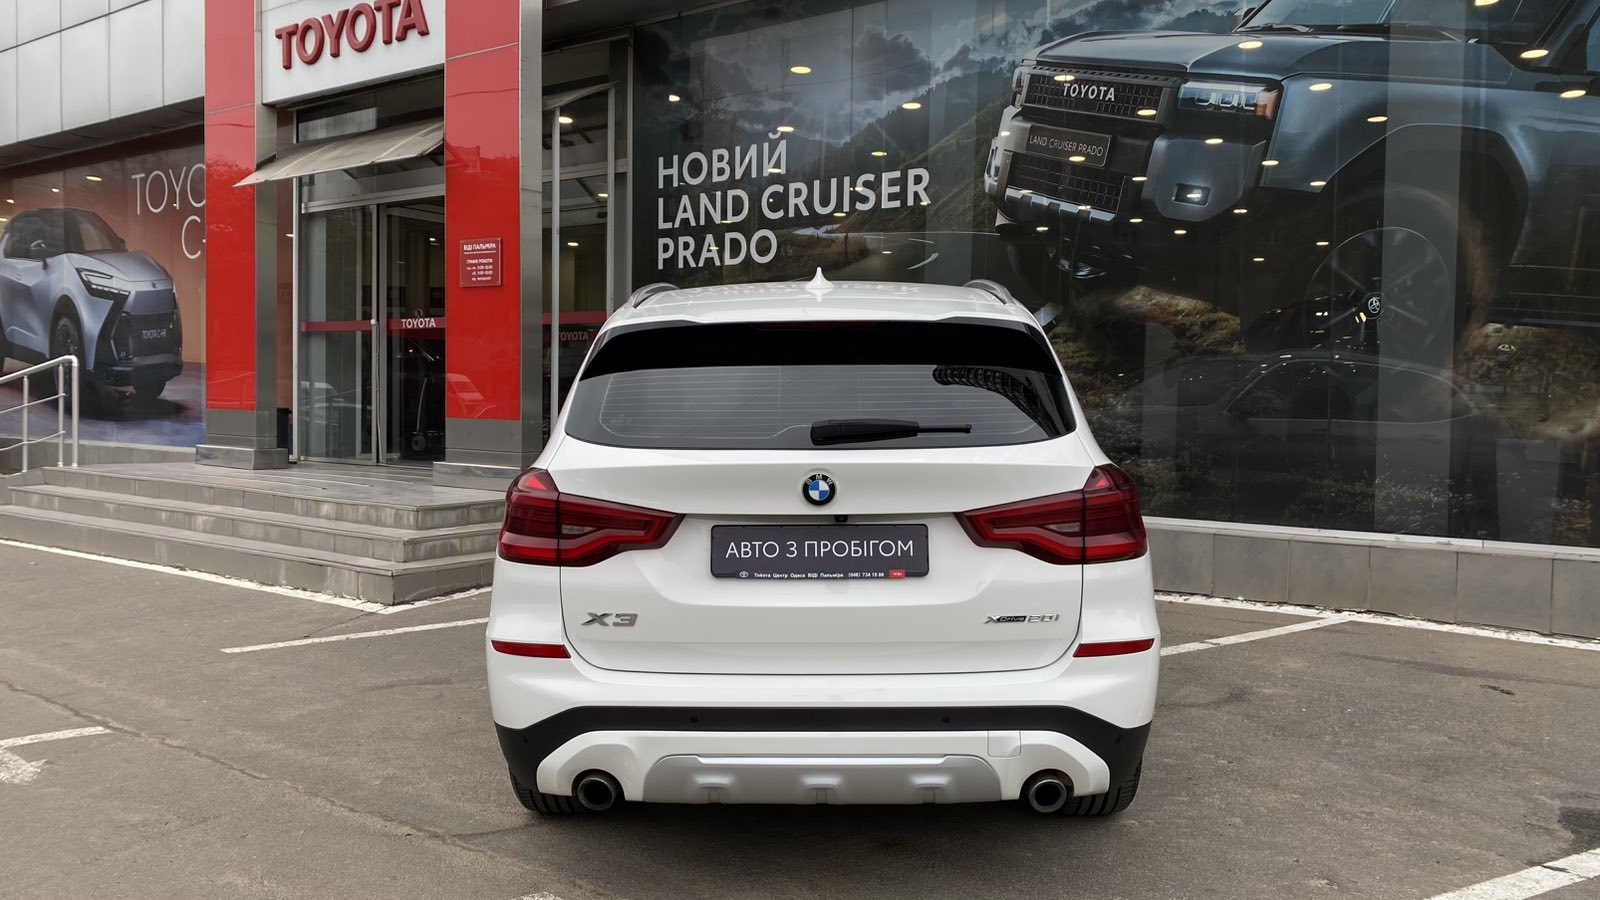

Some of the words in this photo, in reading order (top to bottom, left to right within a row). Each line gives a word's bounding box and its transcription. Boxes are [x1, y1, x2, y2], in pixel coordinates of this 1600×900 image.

[275, 0, 430, 70] TOYOTA
[1063, 82, 1115, 101] TOYOTA
[1029, 134, 1048, 147] LAND
[1048, 138, 1077, 152] CRUISER
[1077, 143, 1104, 157] PRADO
[658, 131, 787, 189] НОВИЙ
[658, 188, 749, 230] LAND
[760, 167, 931, 220] CRUISER
[658, 228, 778, 270] PRADO
[401, 317, 436, 329] TOYOTA
[560, 331, 589, 341] OYOTA
[805, 474, 834, 485] BMW
[725, 541, 780, 558] АВТО
[785, 540, 798, 558] З
[804, 540, 914, 558] ПРОБІГОМ
[581, 612, 638, 627] X3
